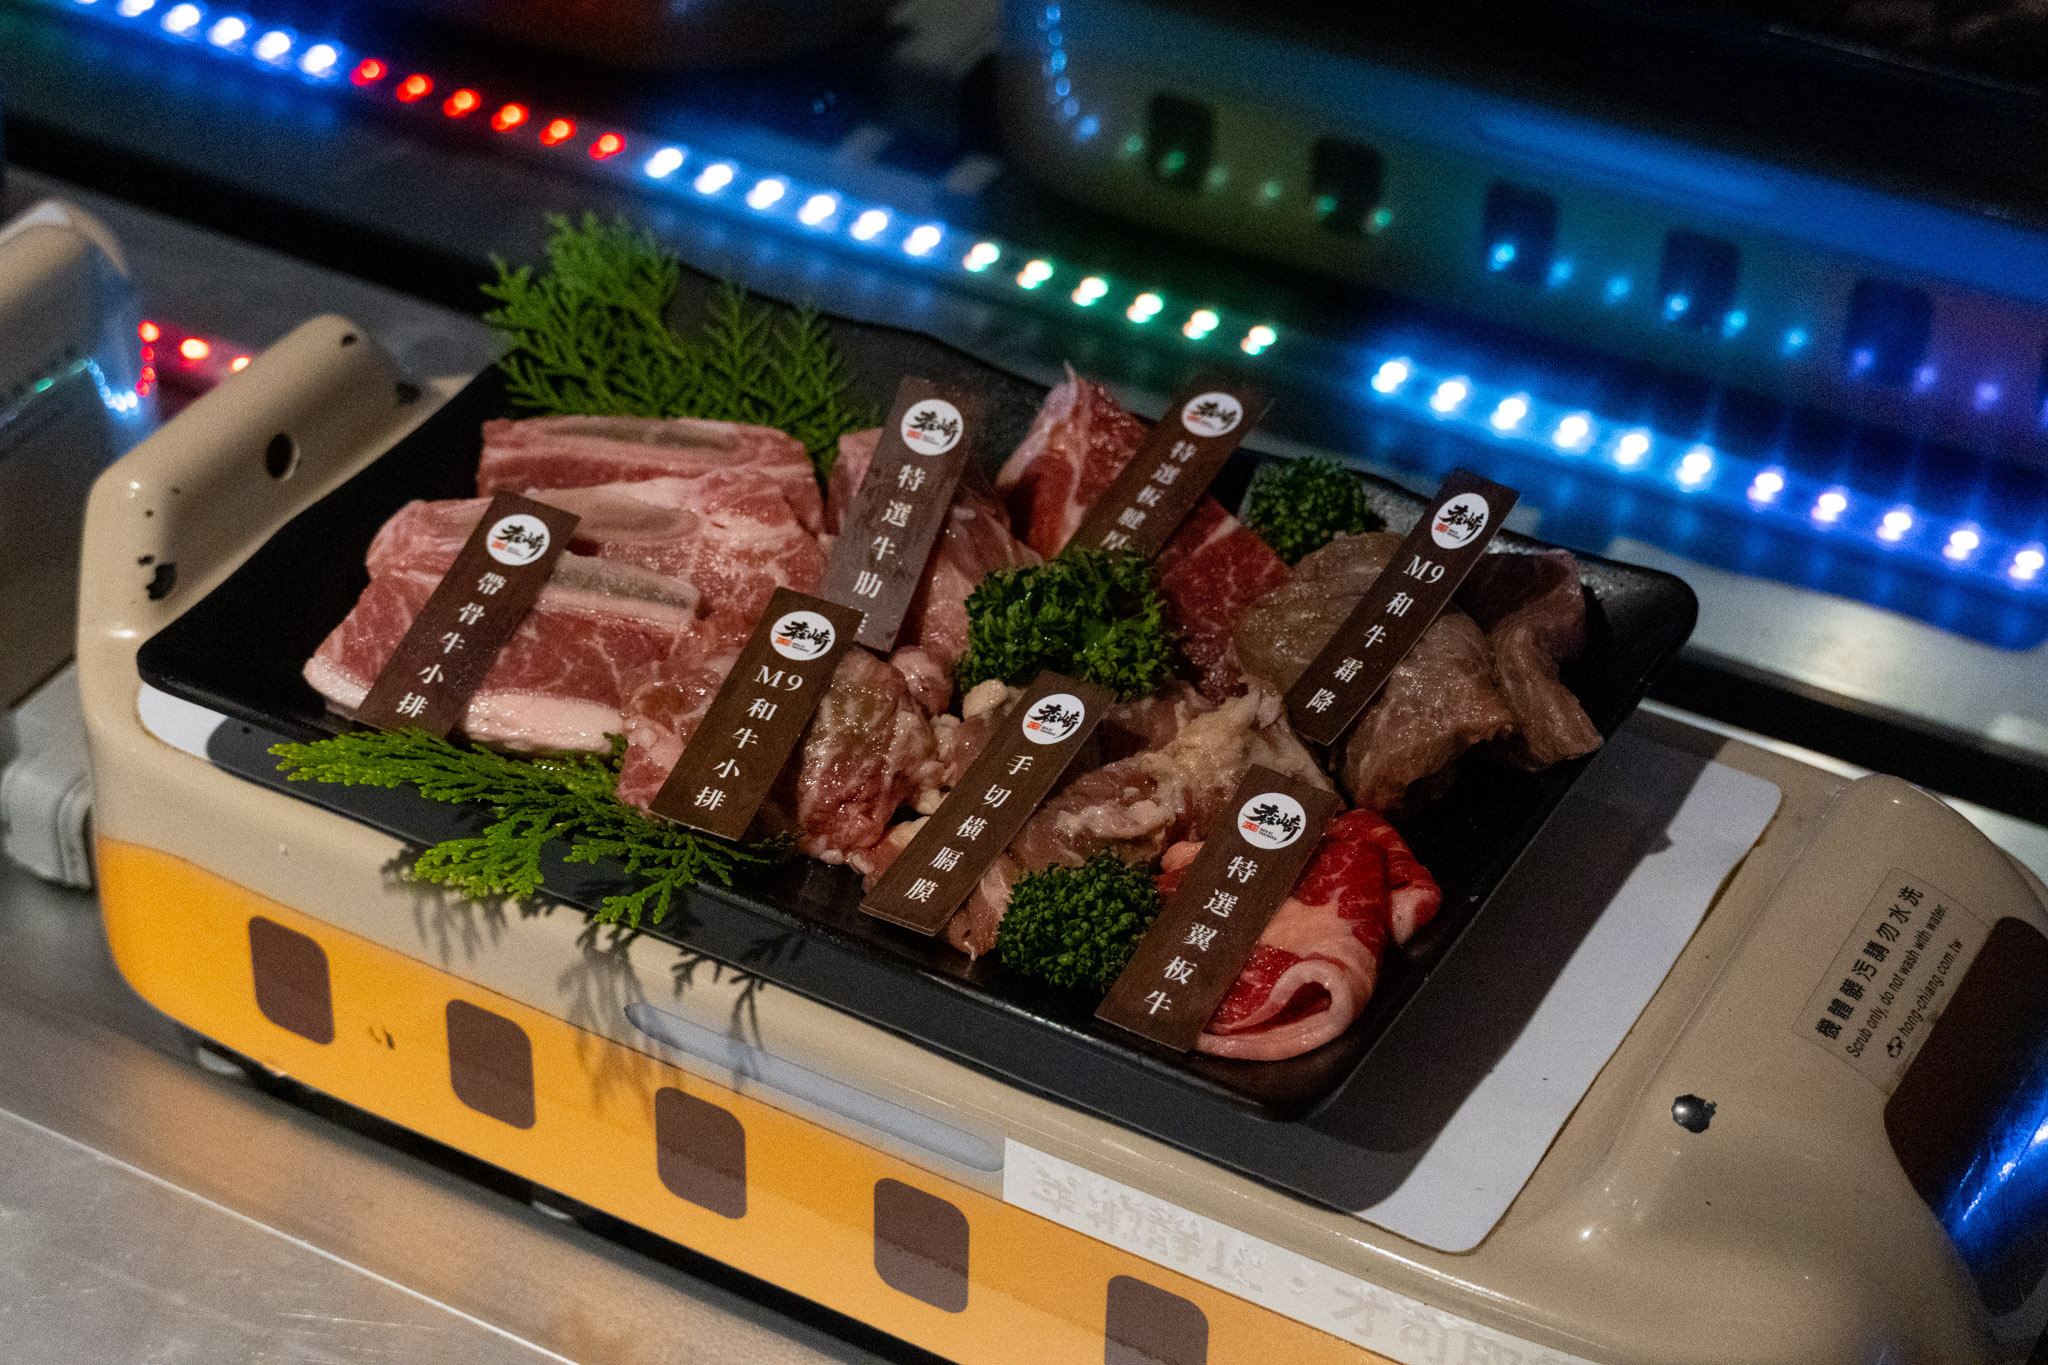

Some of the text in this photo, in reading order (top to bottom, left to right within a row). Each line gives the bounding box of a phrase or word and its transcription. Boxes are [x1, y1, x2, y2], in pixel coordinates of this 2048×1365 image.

[849, 465, 926, 635] 特選牛肋
[396, 572, 508, 719] 帶骨牛小排
[904, 755, 1036, 904] 手切橫膈膜
[1143, 855, 1258, 1015] 特選翼板牛
[1815, 886, 1923, 1040] 機體髒污請勿水洗
[1846, 904, 1949, 1058] Scrub only, do not wash with water.
[1897, 937, 1963, 1038] hong-chiang.com.tw
